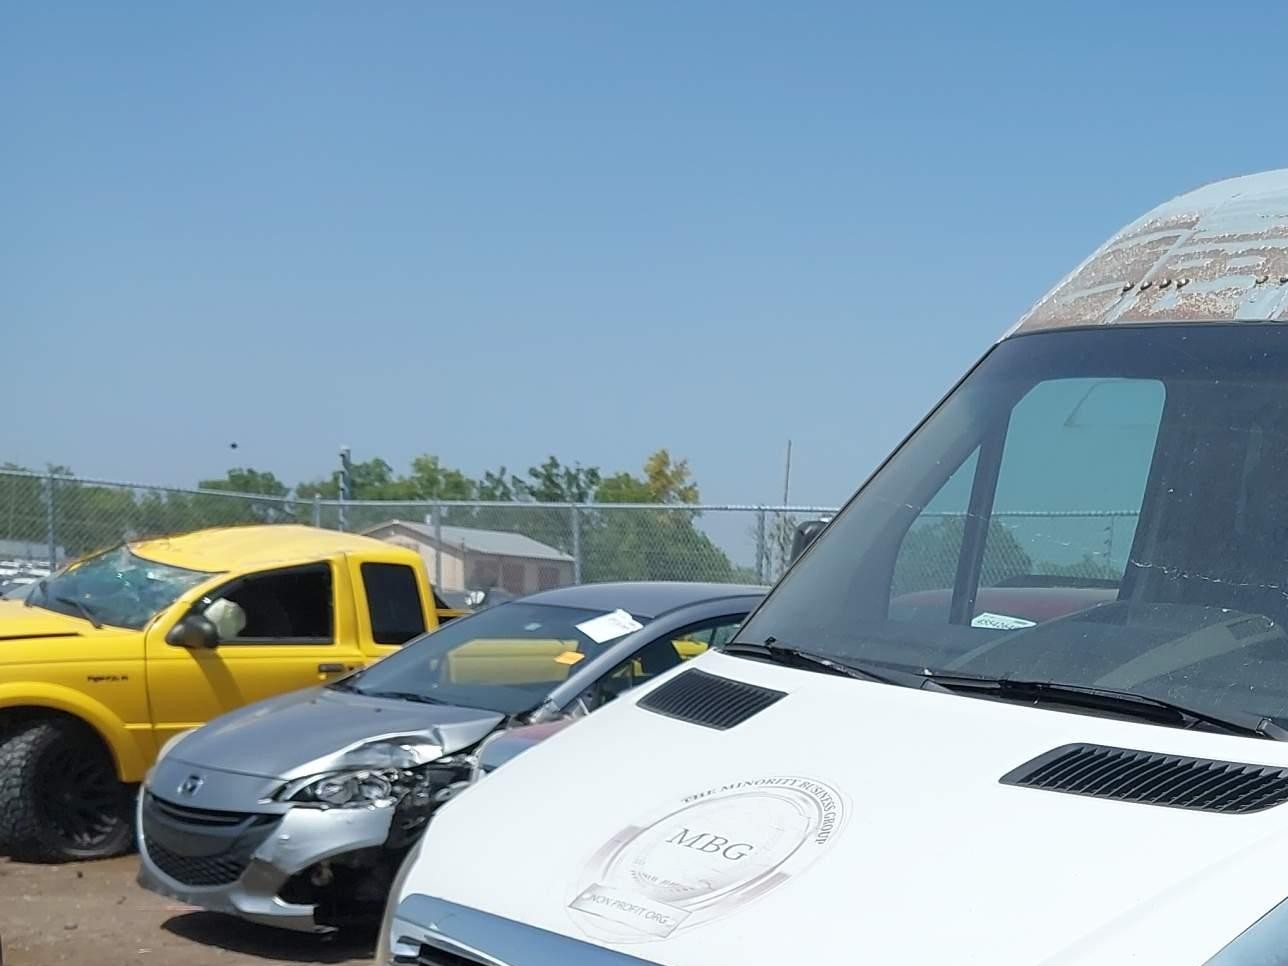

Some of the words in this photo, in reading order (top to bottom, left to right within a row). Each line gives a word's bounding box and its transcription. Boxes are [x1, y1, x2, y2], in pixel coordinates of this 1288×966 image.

[681, 789, 715, 803] THE
[720, 777, 799, 792] MINORITY
[798, 780, 837, 812] BUSINESS
[666, 827, 754, 861] MBG
[814, 812, 838, 845] GROUP
[590, 893, 611, 906] NON
[610, 900, 646, 917] PROFIT
[644, 909, 671, 926] ORG
